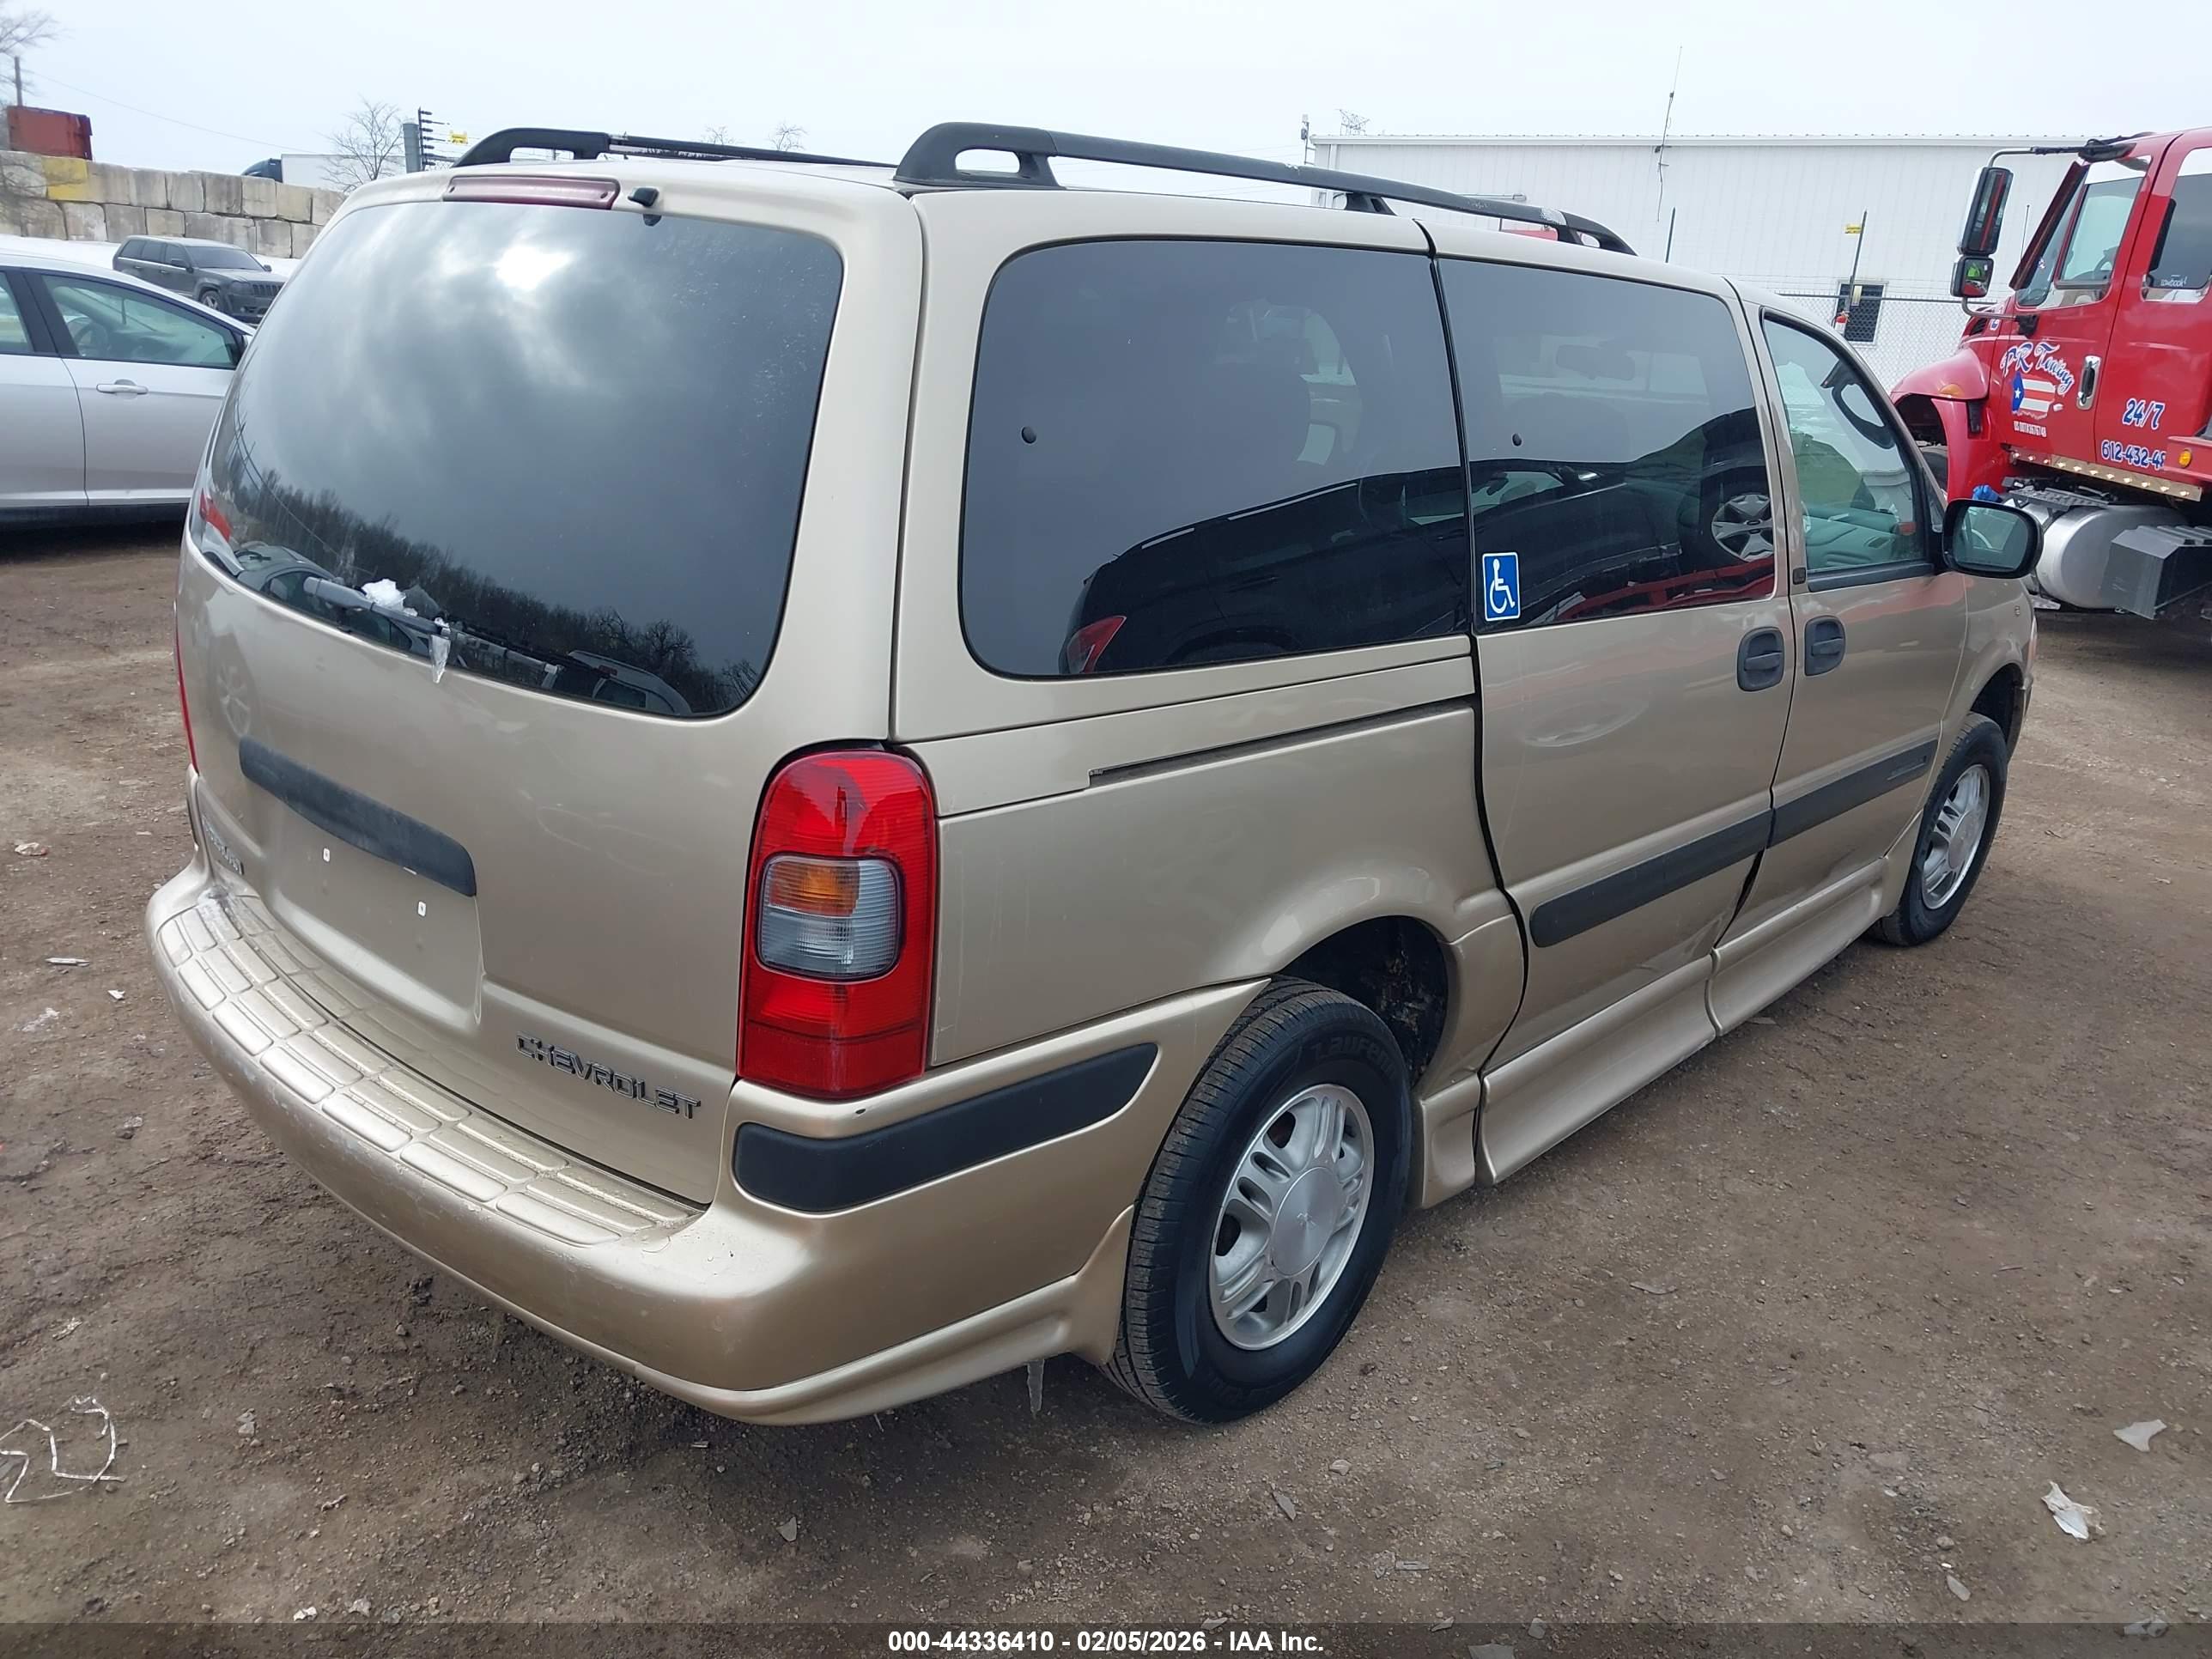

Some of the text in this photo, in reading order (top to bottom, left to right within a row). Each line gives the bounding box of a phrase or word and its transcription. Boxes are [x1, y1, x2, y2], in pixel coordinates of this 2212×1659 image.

[2000, 342, 2075, 396] PR Towing
[2122, 398, 2165, 430] 24/7
[515, 1032, 702, 1120] CHEVROLET
